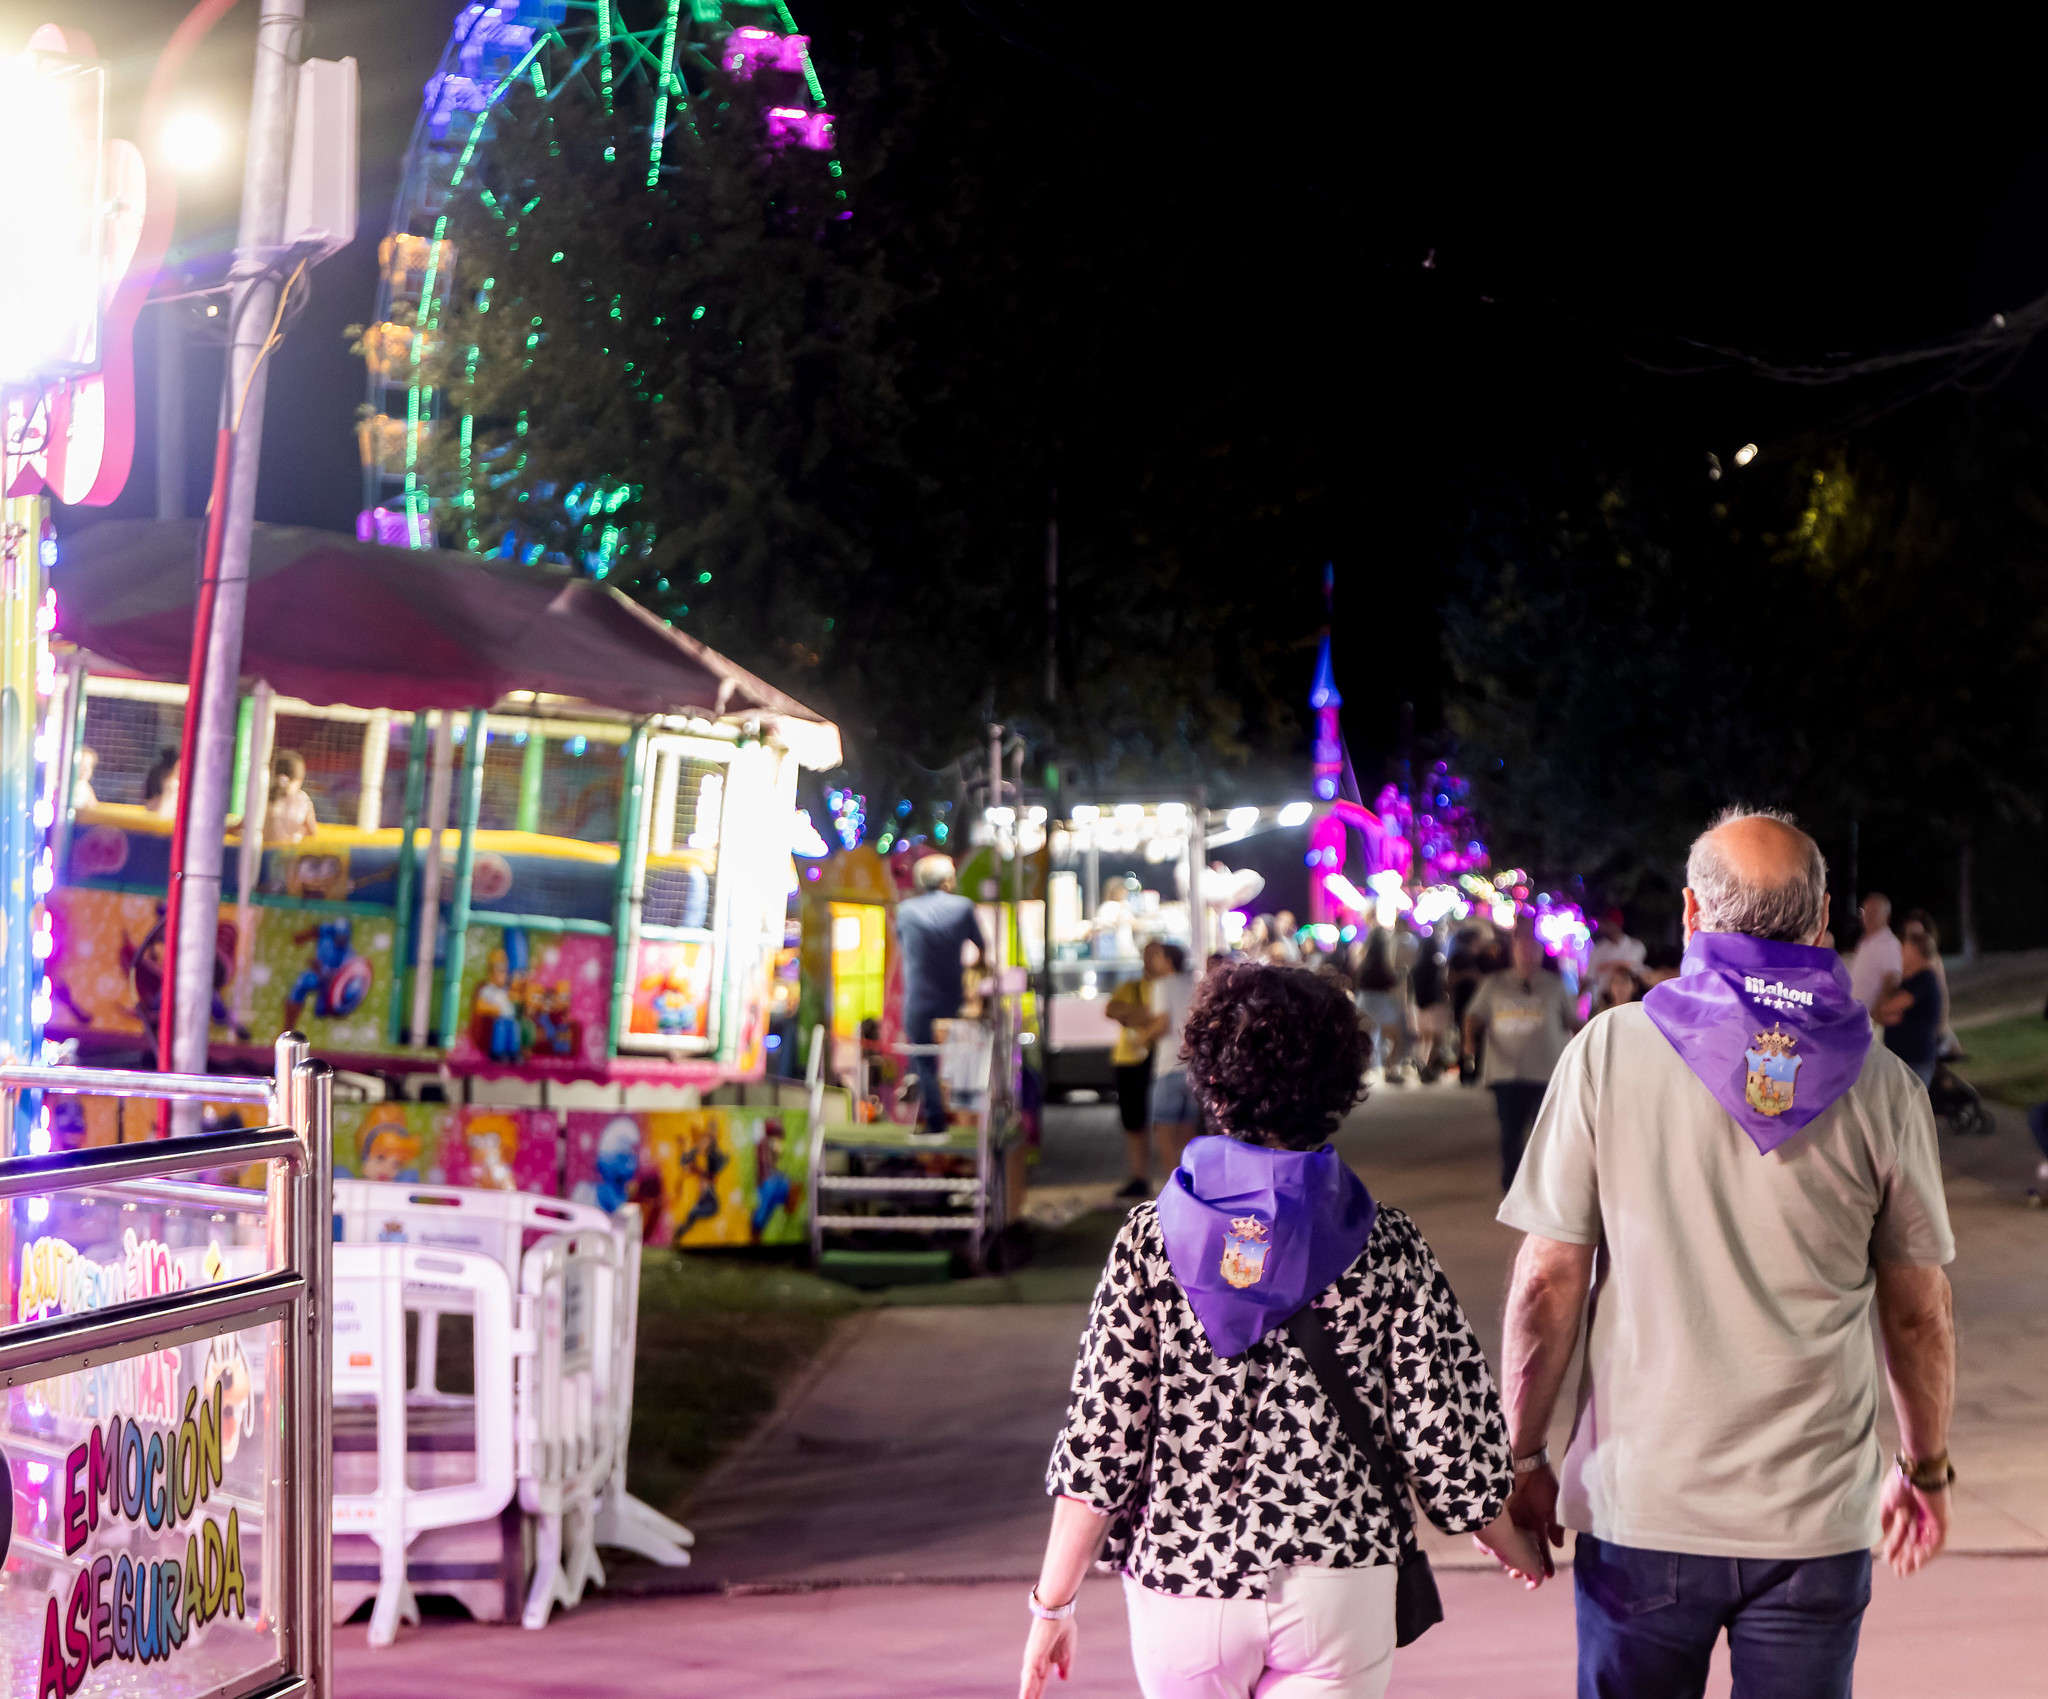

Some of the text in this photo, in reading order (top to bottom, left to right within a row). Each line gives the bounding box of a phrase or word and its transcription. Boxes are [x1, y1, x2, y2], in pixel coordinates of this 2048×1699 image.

[1744, 976, 1814, 1006] Mahou
[64, 1381, 222, 1556] EMOCIÓN
[38, 1507, 245, 1699] ASEGURADA
